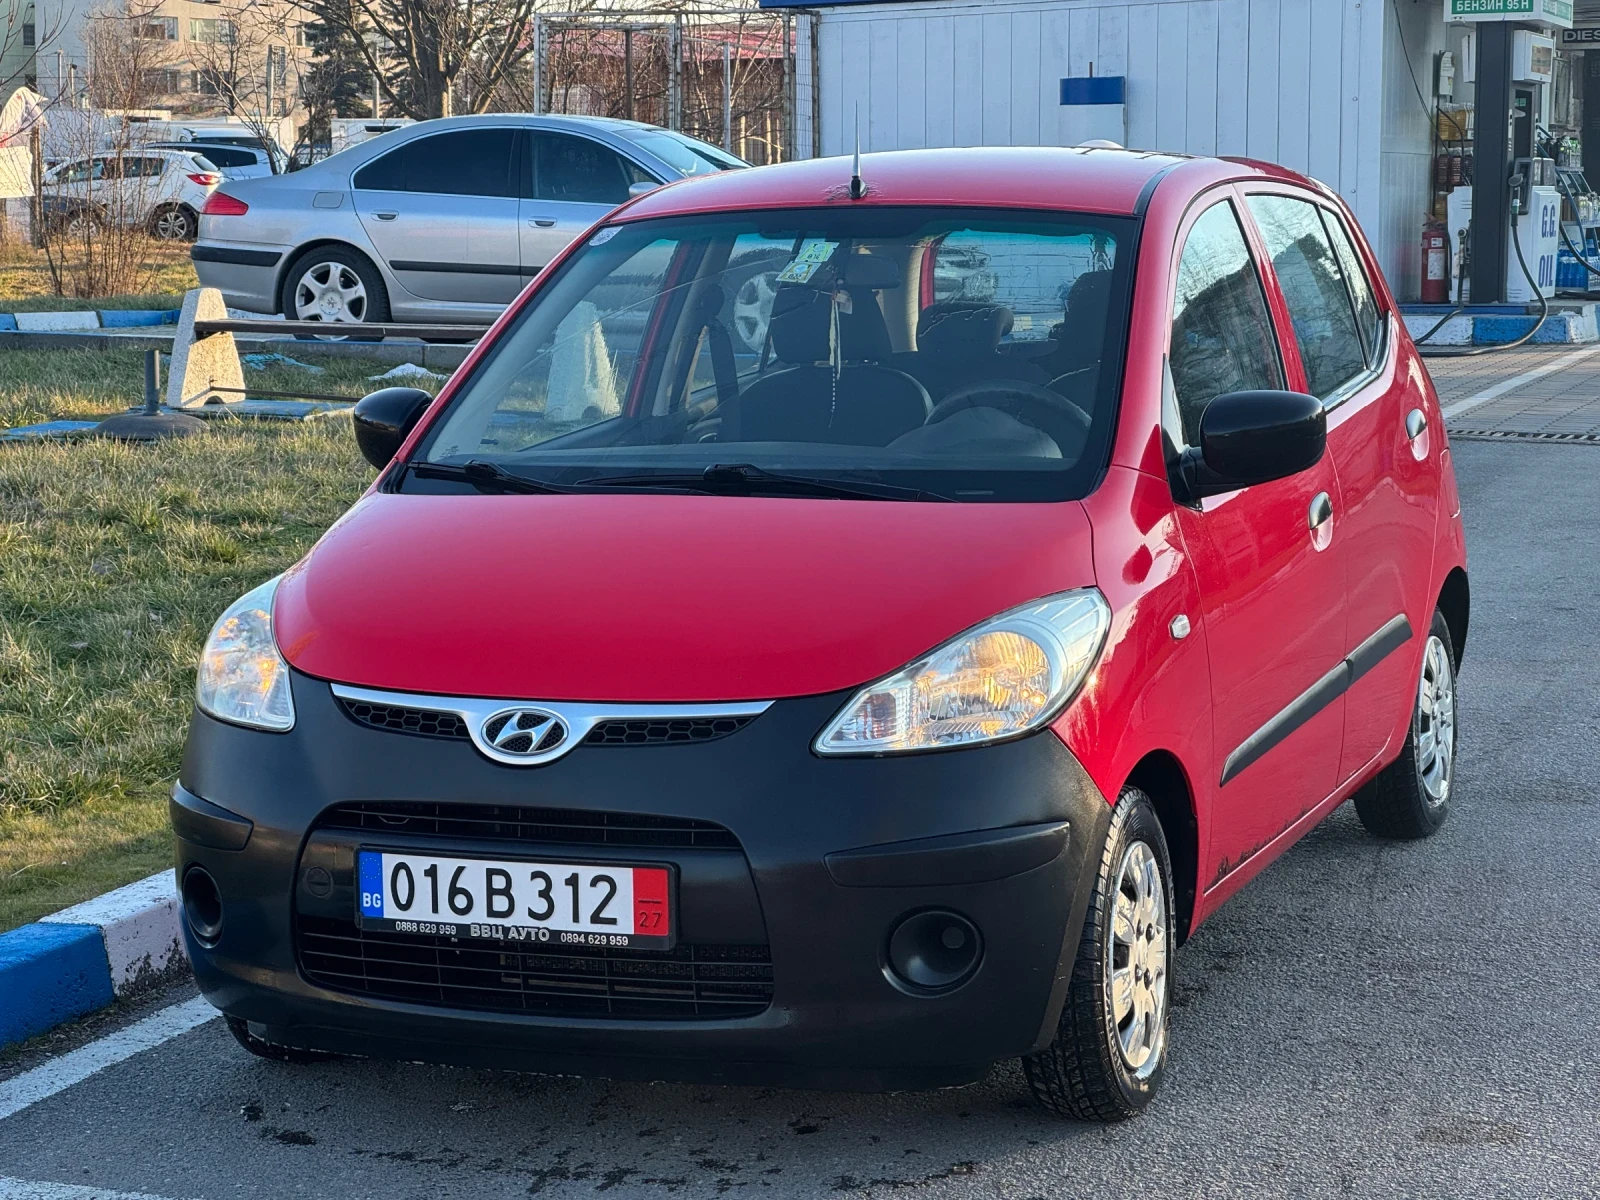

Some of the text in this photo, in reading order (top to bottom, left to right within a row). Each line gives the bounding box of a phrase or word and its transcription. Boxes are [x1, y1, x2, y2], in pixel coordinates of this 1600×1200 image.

[1456, 0, 1503, 11] БЕНЗИН
[1506, 0, 1519, 9] 95
[1538, 254, 1553, 288] OIL
[362, 892, 382, 908] BG
[395, 921, 457, 935] 0888 629 959
[639, 911, 662, 929] 27
[470, 924, 550, 941] ВВЦ АУТО
[560, 932, 629, 946] 0894 629 959
